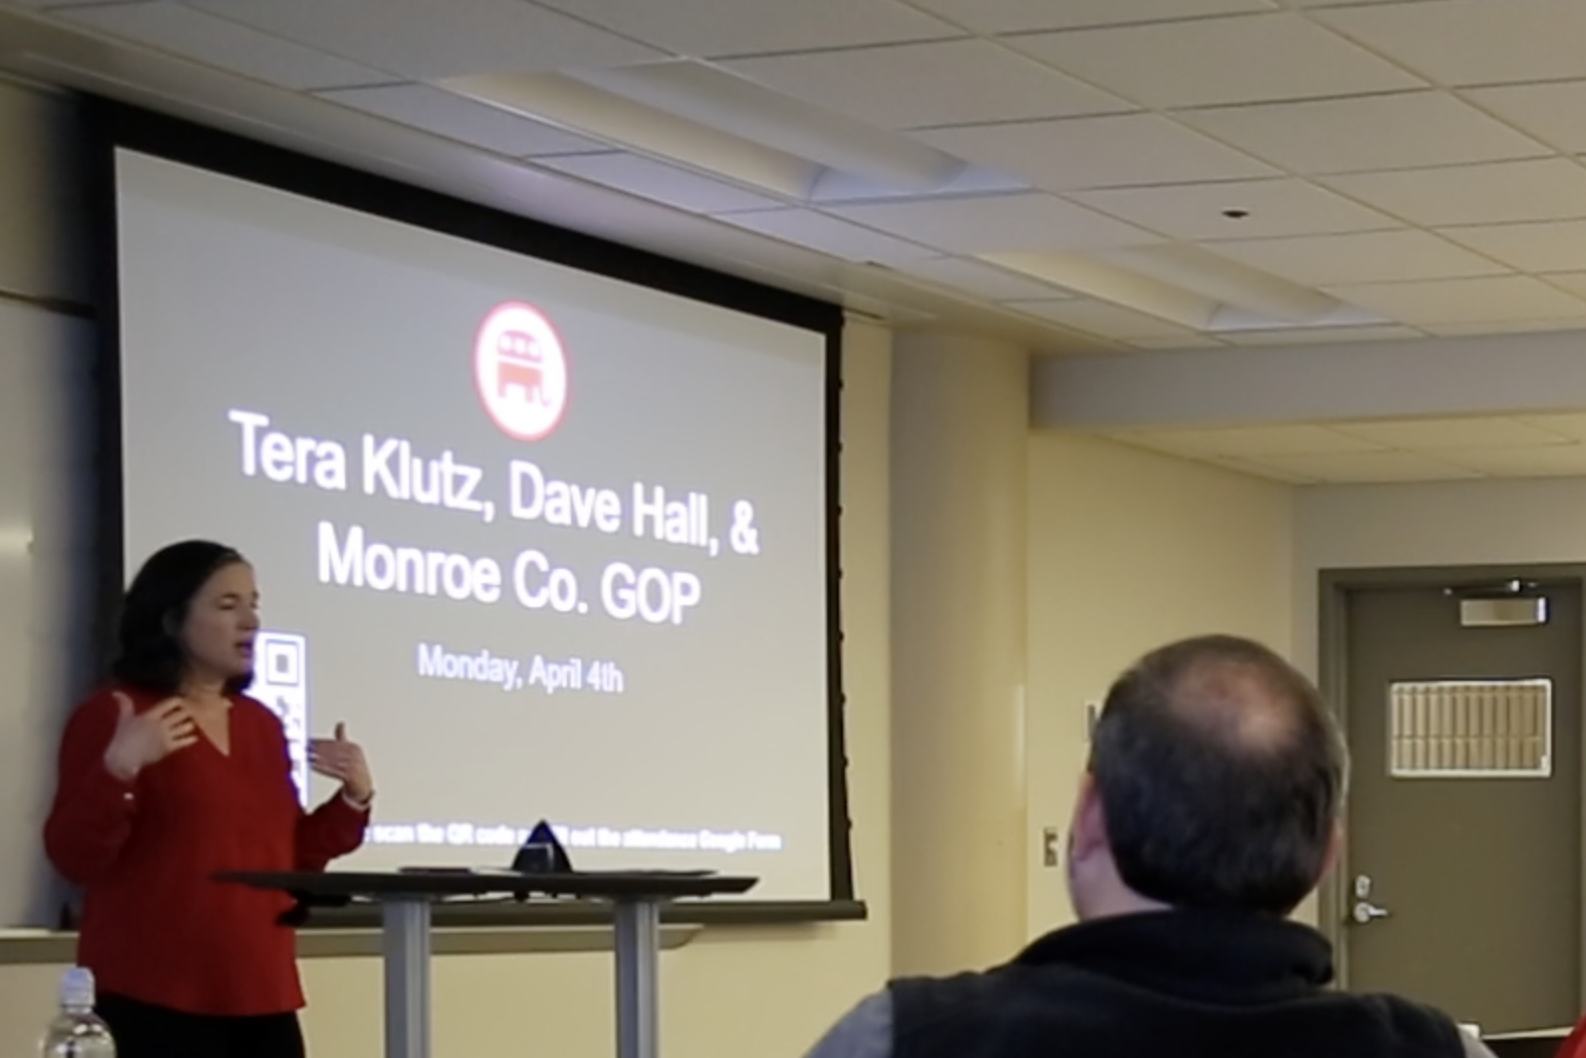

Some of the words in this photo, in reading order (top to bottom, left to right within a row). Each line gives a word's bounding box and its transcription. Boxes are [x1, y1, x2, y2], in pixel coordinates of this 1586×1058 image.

[228, 409, 346, 490] Tera
[363, 433, 495, 523] Klutz,
[509, 459, 621, 533] Dave
[633, 481, 719, 557] Hall,
[730, 499, 759, 555] &
[318, 520, 501, 603] Monroe
[513, 549, 588, 614] Co.
[600, 561, 701, 625] GOP
[417, 643, 523, 691] Monday,
[528, 654, 582, 694] April
[586, 660, 624, 692] 4th
[416, 822, 445, 843] the
